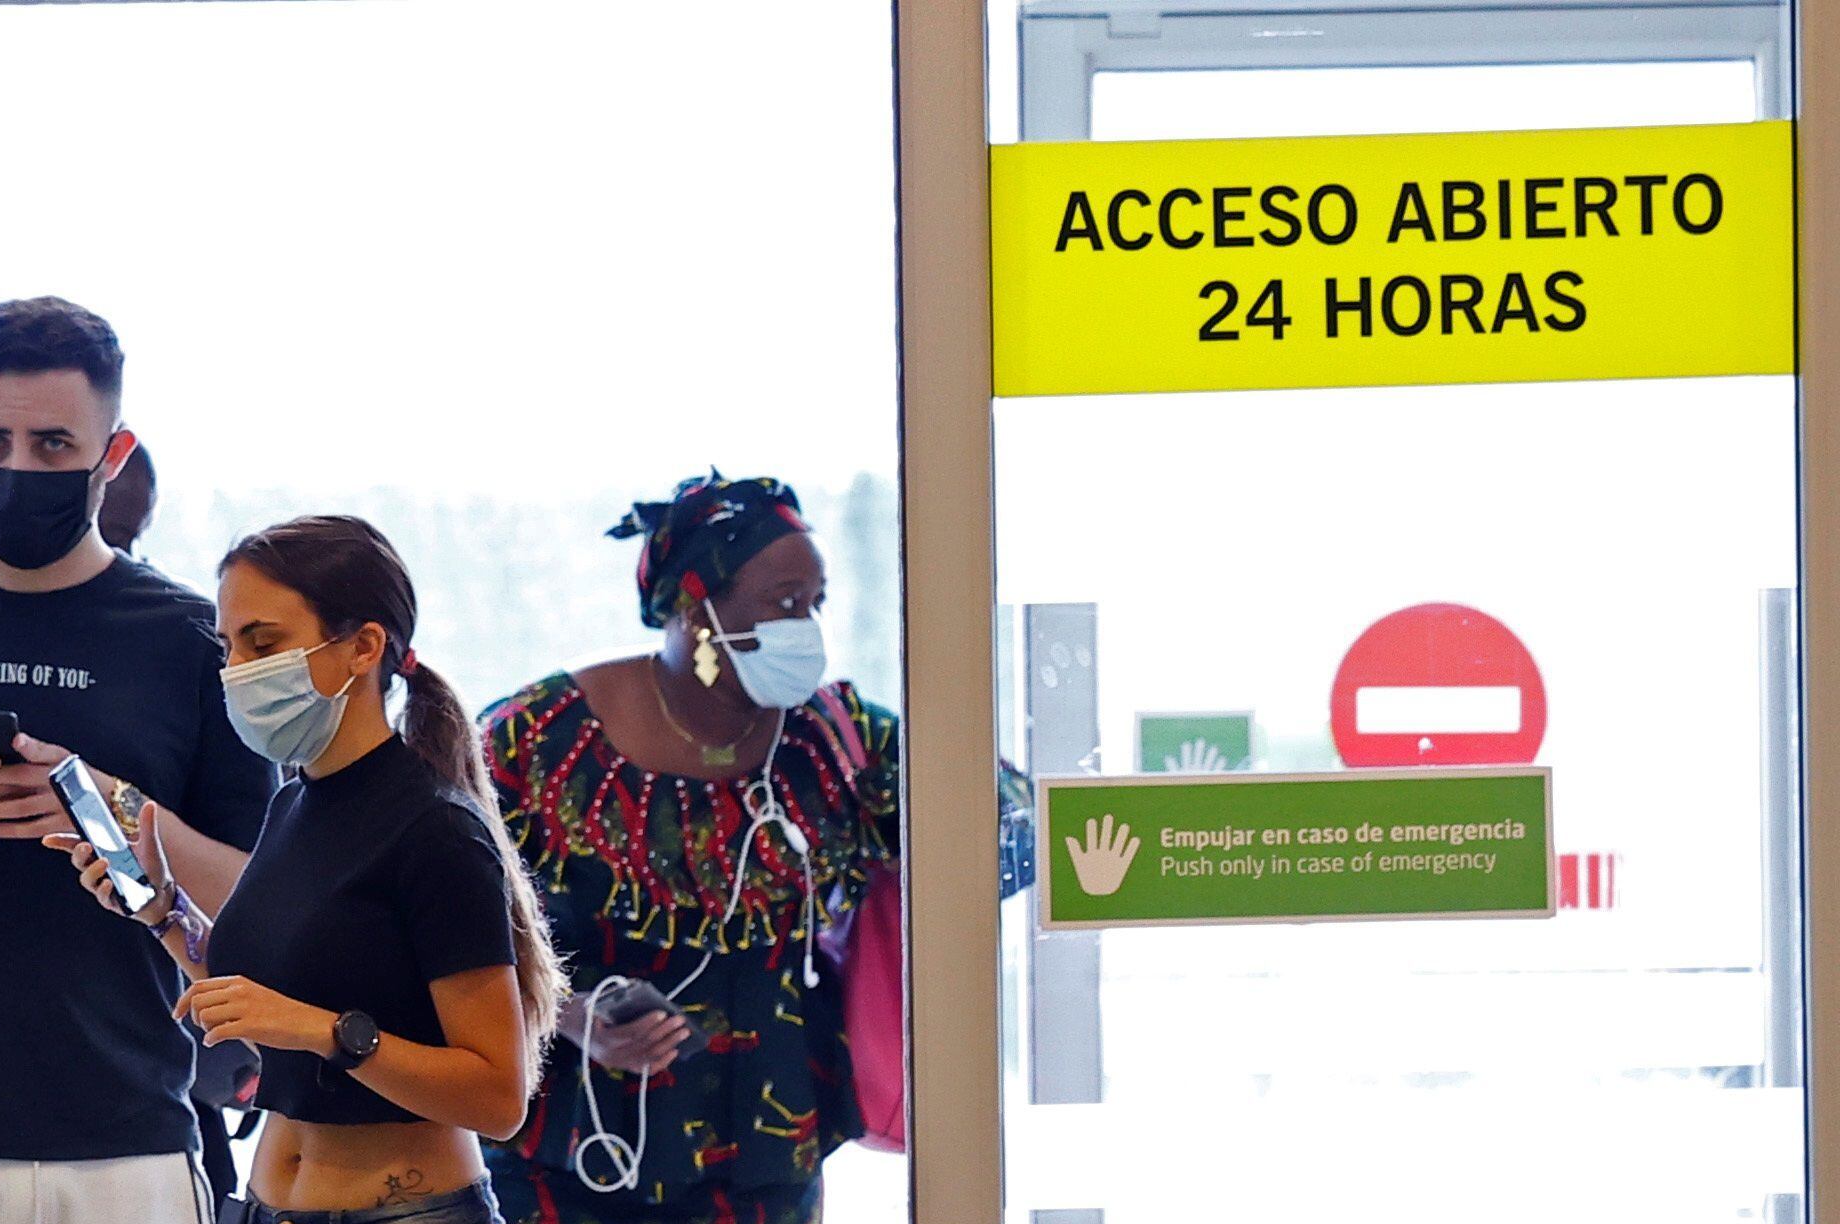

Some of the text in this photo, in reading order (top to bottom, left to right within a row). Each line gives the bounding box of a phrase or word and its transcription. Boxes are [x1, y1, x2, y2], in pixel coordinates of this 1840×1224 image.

[1053, 172, 1725, 253] ACCESO ABIERTO
[1196, 270, 1588, 342] 24 HORAS
[32, 664, 54, 687] OF
[1160, 817, 1526, 852] Empujar en caso de emergencia
[1160, 851, 1497, 880] Push only in case of emergency
